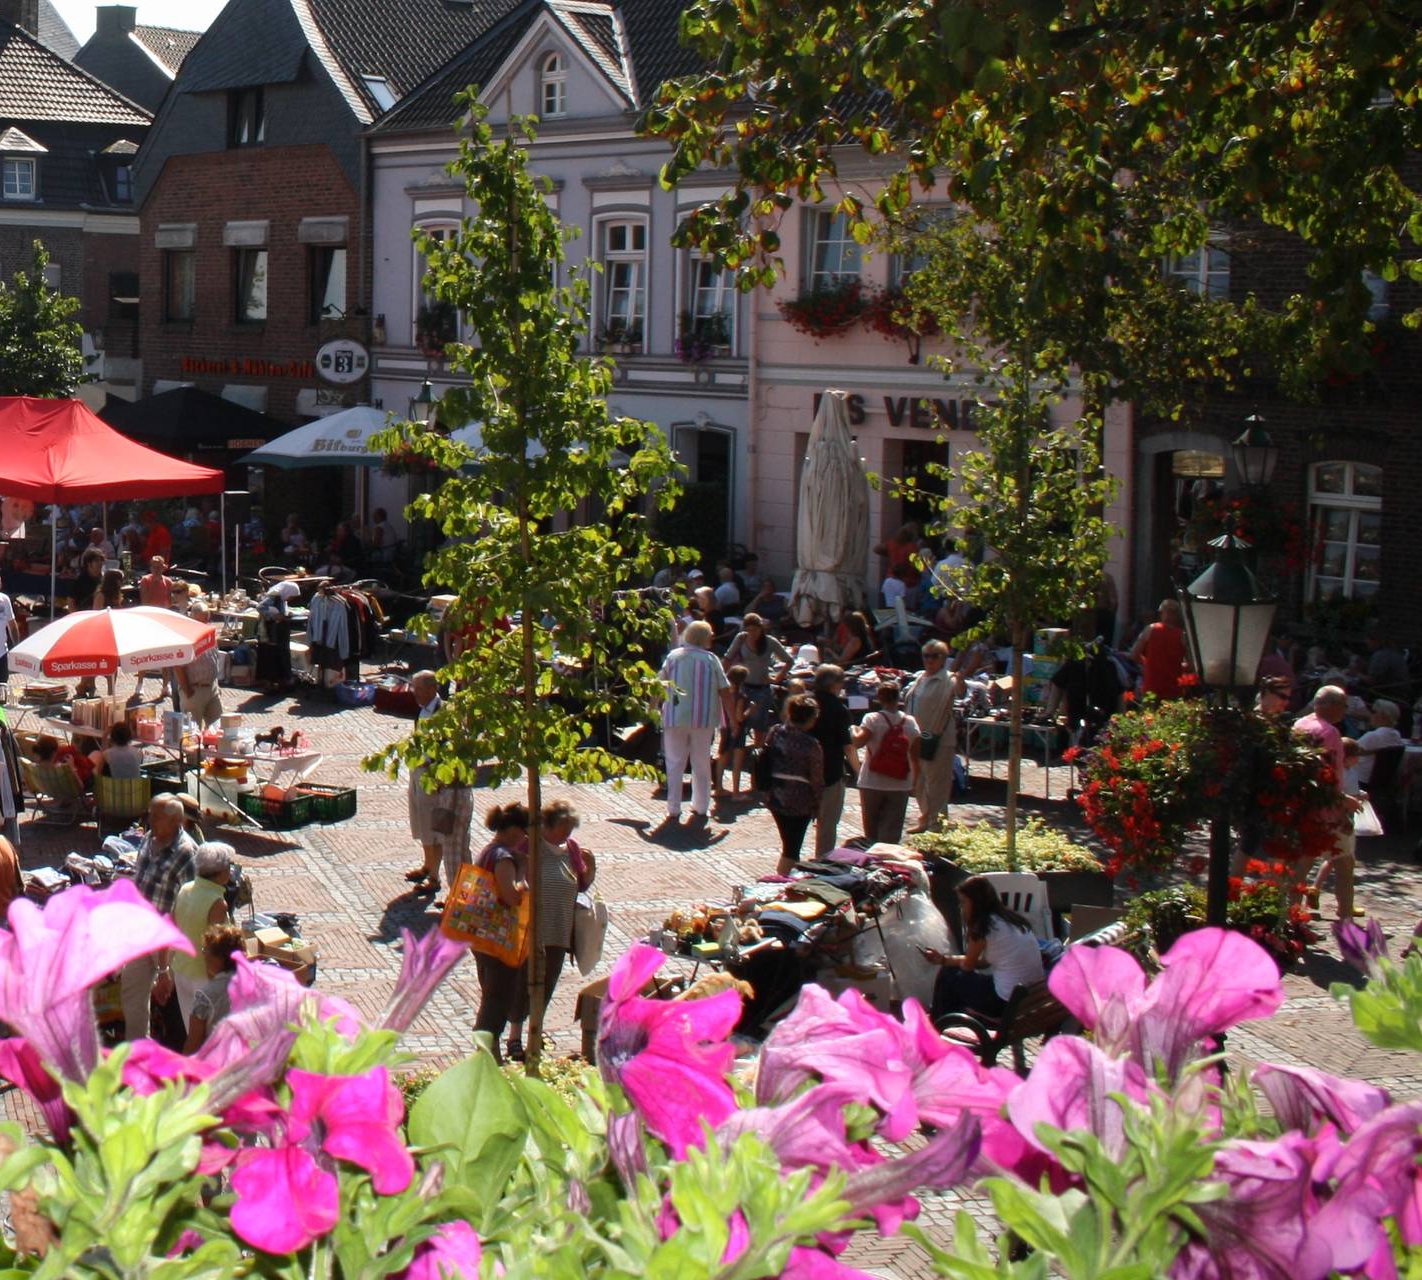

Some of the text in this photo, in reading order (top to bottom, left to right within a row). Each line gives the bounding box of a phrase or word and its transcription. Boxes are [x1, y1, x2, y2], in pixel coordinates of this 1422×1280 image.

[339, 357, 349, 373] 3
[51, 659, 98, 673] Sparkasse
[130, 652, 174, 666] Sparkasse
